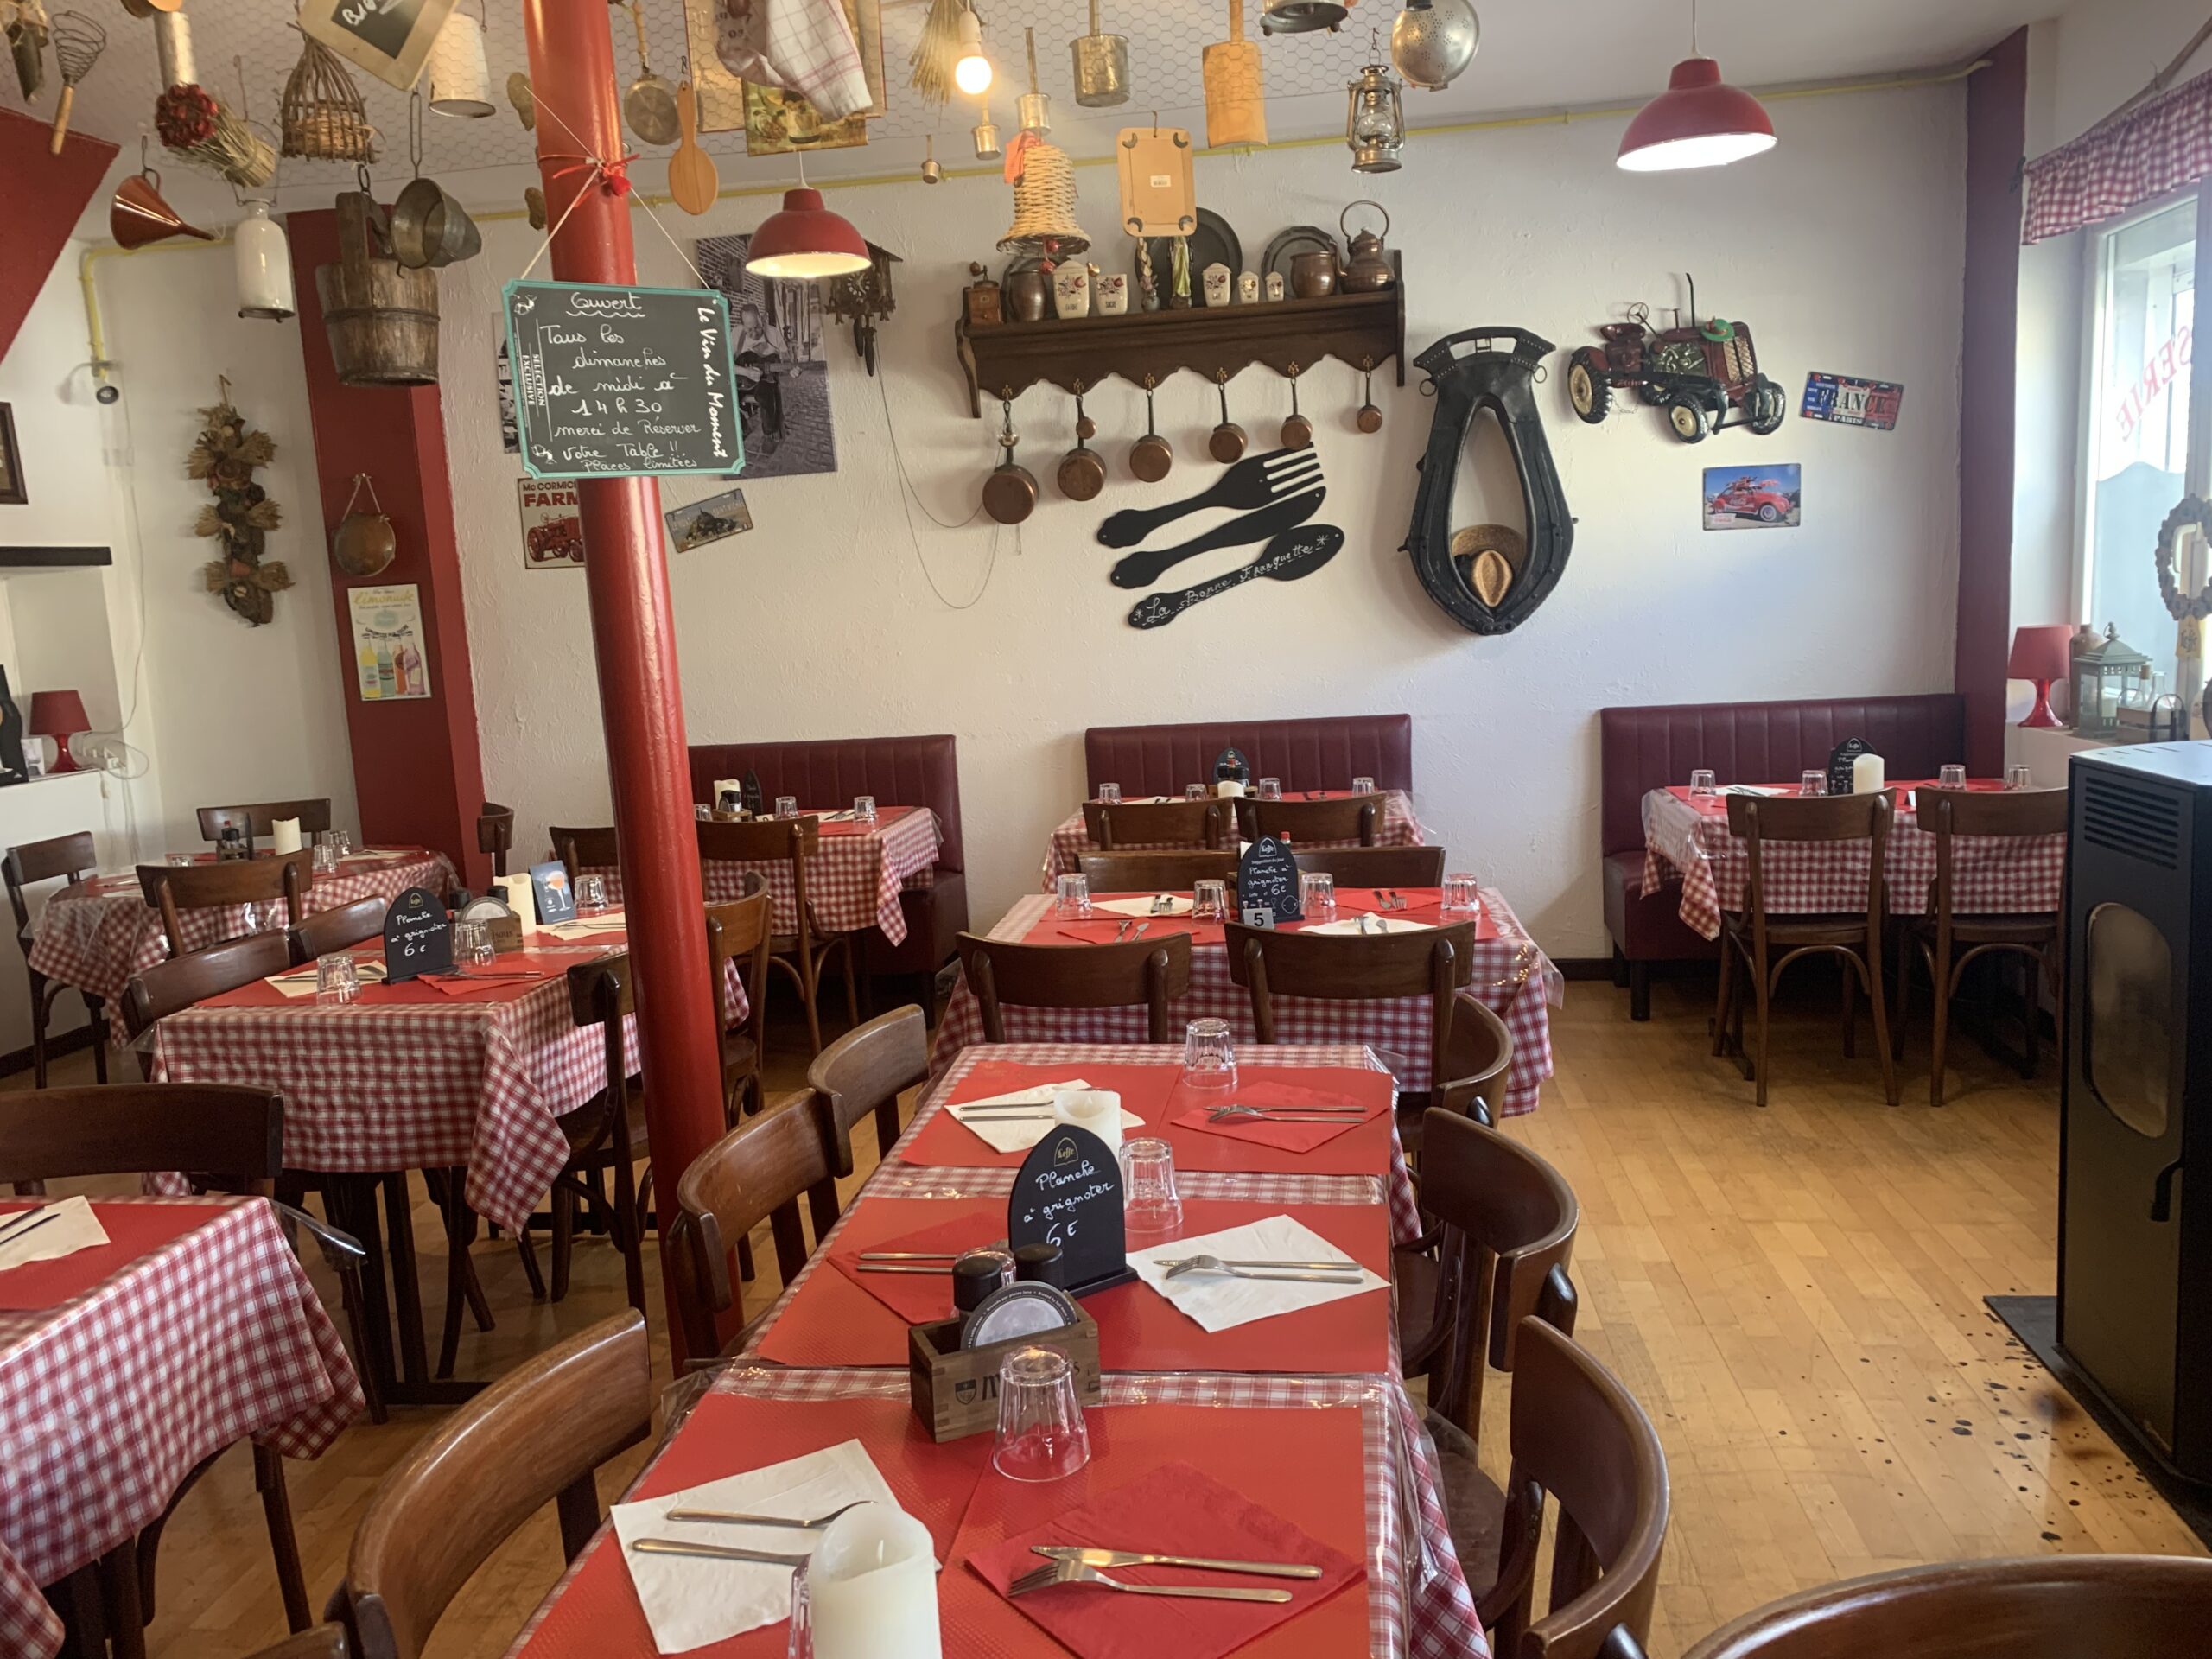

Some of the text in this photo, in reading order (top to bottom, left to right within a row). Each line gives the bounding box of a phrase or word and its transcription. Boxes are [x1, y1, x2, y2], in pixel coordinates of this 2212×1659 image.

[600, 323, 625, 344] les
[572, 346, 667, 370] dimanches
[522, 354, 536, 406] EXCLUSIVE
[532, 353, 546, 407] SELECTION
[548, 375, 580, 395] de
[593, 375, 645, 391] midi
[697, 307, 728, 459] Le Vin du Moment
[554, 423, 607, 437] merci
[612, 421, 634, 435] de
[1834, 414, 1864, 425] PARIS
[616, 442, 664, 459] Table
[1146, 596, 1172, 623] La
[1182, 578, 1232, 606] Bonne
[1254, 912, 1264, 927] 5
[1035, 1160, 1101, 1191] Planche
[1042, 1182, 1116, 1220] grignoter
